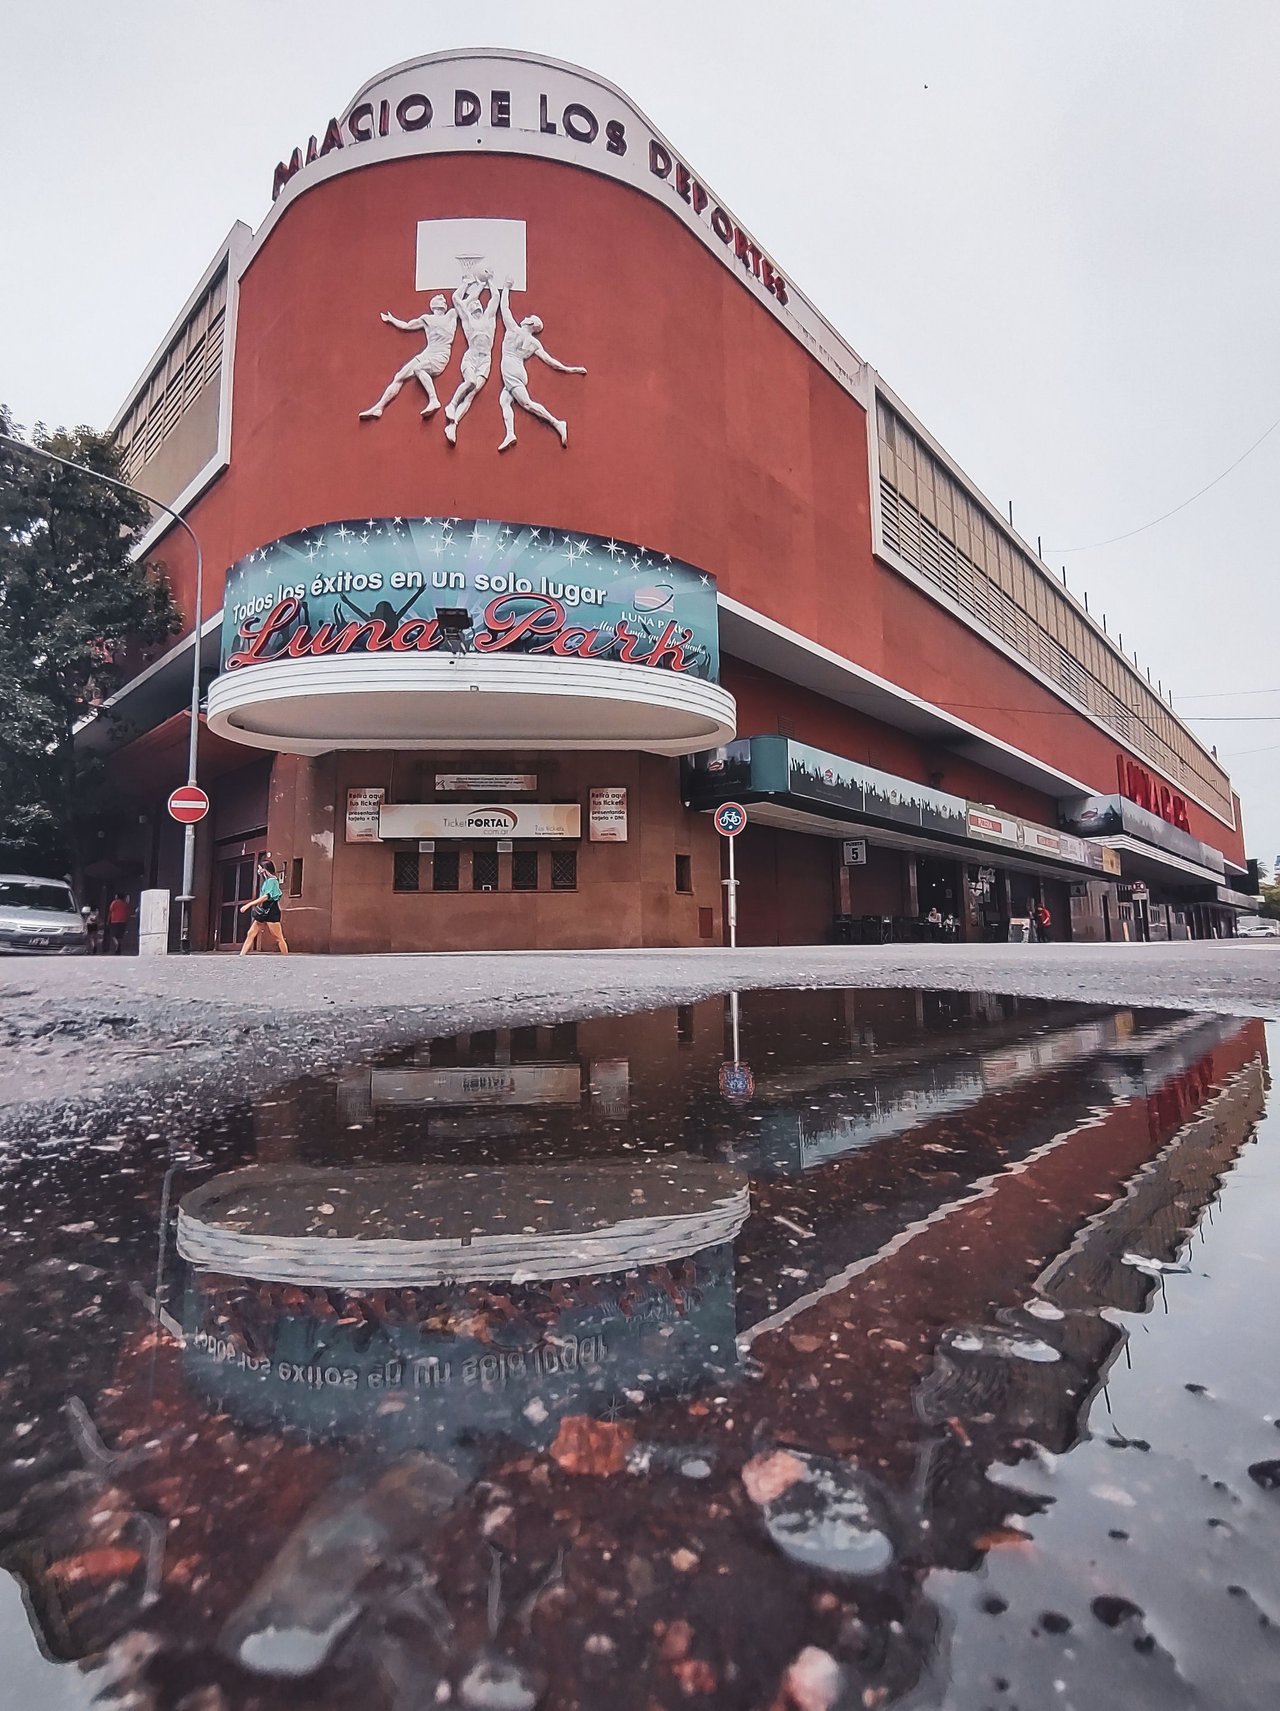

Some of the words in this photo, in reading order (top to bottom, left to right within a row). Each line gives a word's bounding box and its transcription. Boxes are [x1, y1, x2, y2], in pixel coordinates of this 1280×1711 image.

[272, 93, 433, 201] PALACIO
[455, 90, 510, 127] DE
[540, 94, 627, 157] LOS
[649, 139, 789, 306] DEPORTES
[233, 593, 273, 625] Todos
[278, 584, 306, 603] los
[310, 571, 382, 596] éxitos
[390, 571, 423, 589] en
[432, 571, 465, 589] un
[474, 571, 532, 593] solo
[541, 576, 607, 606] lugar
[225, 597, 443, 670] Luna
[473, 592, 697, 671] Park
[621, 611, 654, 627] LUNA
[443, 818, 509, 828] TicketPORTAL
[852, 847, 859, 860] 5
